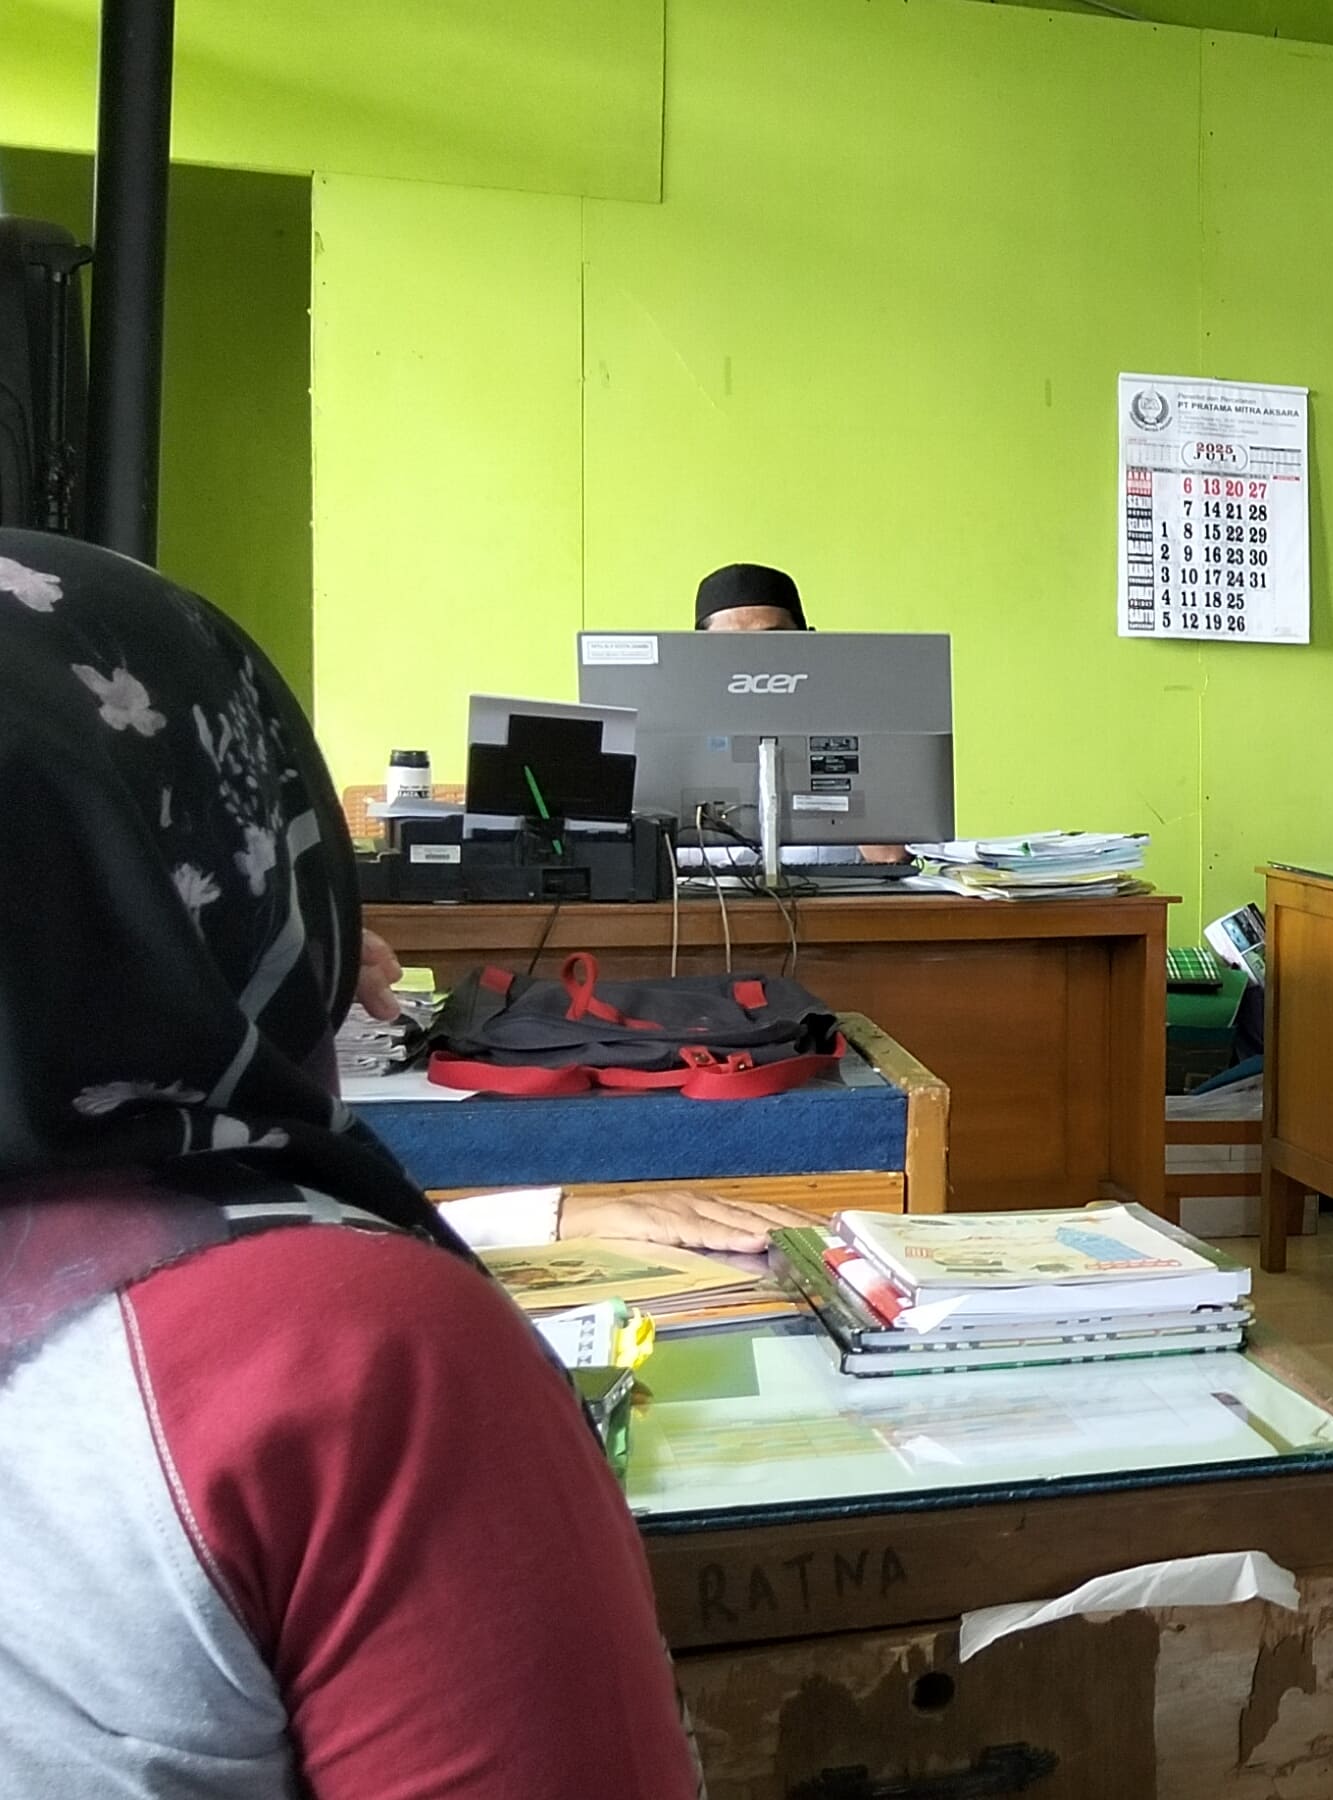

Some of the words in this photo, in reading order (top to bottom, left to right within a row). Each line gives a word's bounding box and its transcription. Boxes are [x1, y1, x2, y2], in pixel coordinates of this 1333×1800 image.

[1191, 403, 1232, 412] PRATAMA
[1235, 406, 1261, 414] MITRA
[1263, 408, 1299, 417] AKSARA
[1193, 452, 1237, 462] JULI
[1196, 442, 1234, 454] 2025
[1183, 478, 1192, 494] 6
[1204, 479, 1220, 495] 13
[1226, 480, 1243, 497] 20
[1250, 482, 1267, 499] 27
[1183, 501, 1192, 516] 7
[1204, 502, 1221, 517] 14
[1226, 503, 1243, 519] 21
[1250, 505, 1267, 521] 28
[1161, 522, 1168, 537] 1
[1184, 523, 1192, 539] 8
[1204, 524, 1221, 540] 15
[1226, 525, 1244, 542] 22
[1250, 527, 1267, 544] 29
[1161, 544, 1170, 560] 2
[1184, 546, 1193, 562] 9
[1204, 547, 1221, 563] 16
[1227, 548, 1244, 564] 23
[1250, 549, 1268, 566] 30
[1161, 567, 1170, 583] 3
[1181, 568, 1198, 584] 10
[1205, 569, 1221, 585] 17
[1227, 570, 1244, 586] 24
[1250, 572, 1266, 588] 31
[1161, 589, 1171, 606] 4
[1181, 591, 1197, 607] 11
[1205, 592, 1222, 608] 18
[1227, 593, 1244, 609] 25
[1162, 611, 1170, 628] 5
[1182, 613, 1199, 629] 12
[1205, 614, 1222, 631] 19
[1227, 615, 1245, 631] 26
[728, 674, 808, 693] acer
[699, 1546, 907, 1628] RATNA
